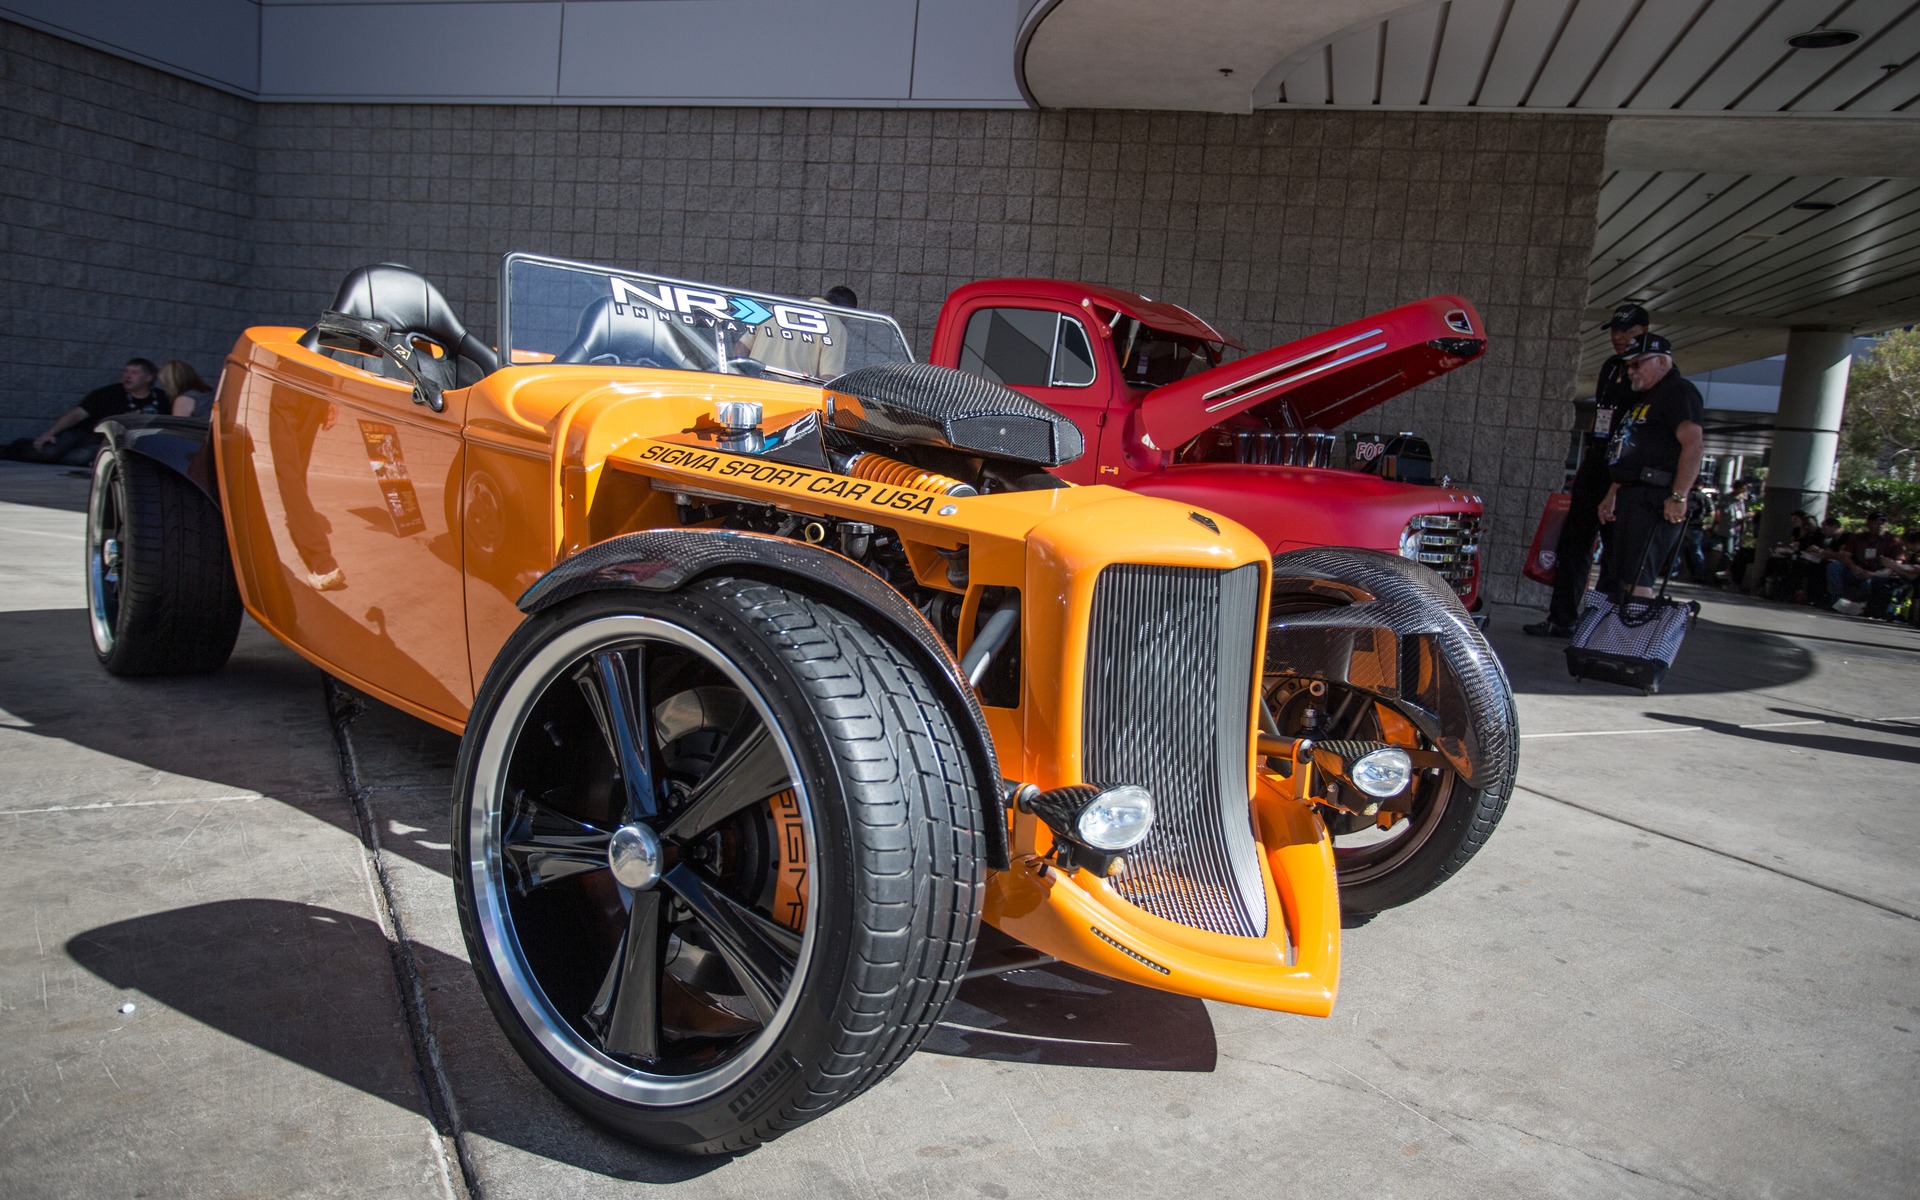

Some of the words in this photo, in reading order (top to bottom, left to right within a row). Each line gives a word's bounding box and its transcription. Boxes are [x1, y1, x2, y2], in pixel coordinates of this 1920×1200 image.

[609, 276, 829, 335] NRG
[616, 304, 834, 346] INNOVATIONS
[640, 446, 720, 472] SIGMA
[719, 460, 812, 488] SPORT
[808, 476, 872, 501] CAR
[871, 488, 935, 514] USA
[727, 1049, 804, 1122] PIRELLI
